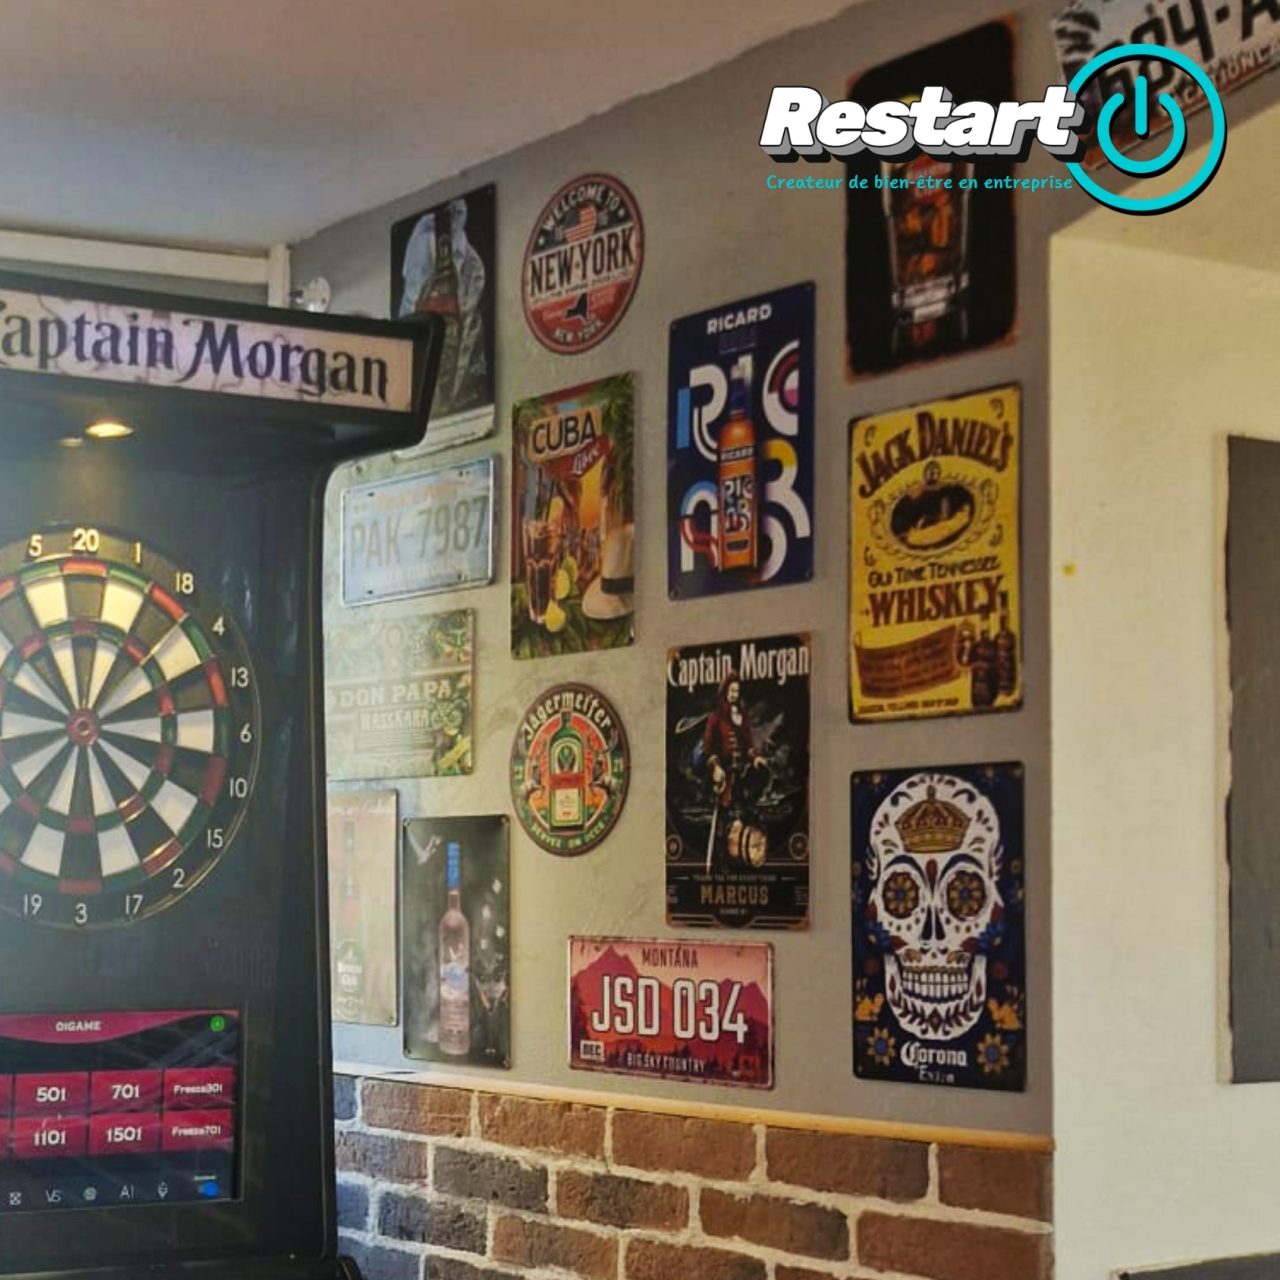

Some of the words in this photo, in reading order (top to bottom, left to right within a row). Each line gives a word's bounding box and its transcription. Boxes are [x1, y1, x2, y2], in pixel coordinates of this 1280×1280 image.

[542, 184, 606, 231] WELCOME
[707, 303, 773, 335] RICARD
[175, 318, 389, 404] Morgan
[532, 410, 600, 455] CUBA
[856, 427, 916, 499] JACK
[28, 534, 43, 556] 5
[73, 528, 100, 553] 20
[135, 542, 142, 564] 1
[176, 573, 195, 595] 18
[868, 574, 1004, 628] WHISKEY
[212, 615, 225, 636] 4
[231, 667, 250, 688] 13
[667, 650, 733, 694] Captain
[738, 642, 810, 687] Morgan
[240, 723, 252, 743] 6
[229, 778, 248, 799] 10
[207, 828, 224, 849] 15
[172, 868, 185, 889] 2
[24, 894, 43, 915] 19
[75, 903, 88, 925] 3
[125, 893, 144, 915] 17
[641, 947, 700, 968] MONTANA
[591, 974, 661, 1036] JSD
[672, 978, 749, 1045] 034
[900, 1040, 968, 1069] Corona
[36, 1086, 67, 1103] 501
[111, 1083, 140, 1100] 701
[33, 1130, 67, 1147] 1101
[106, 1127, 142, 1143] 1501
